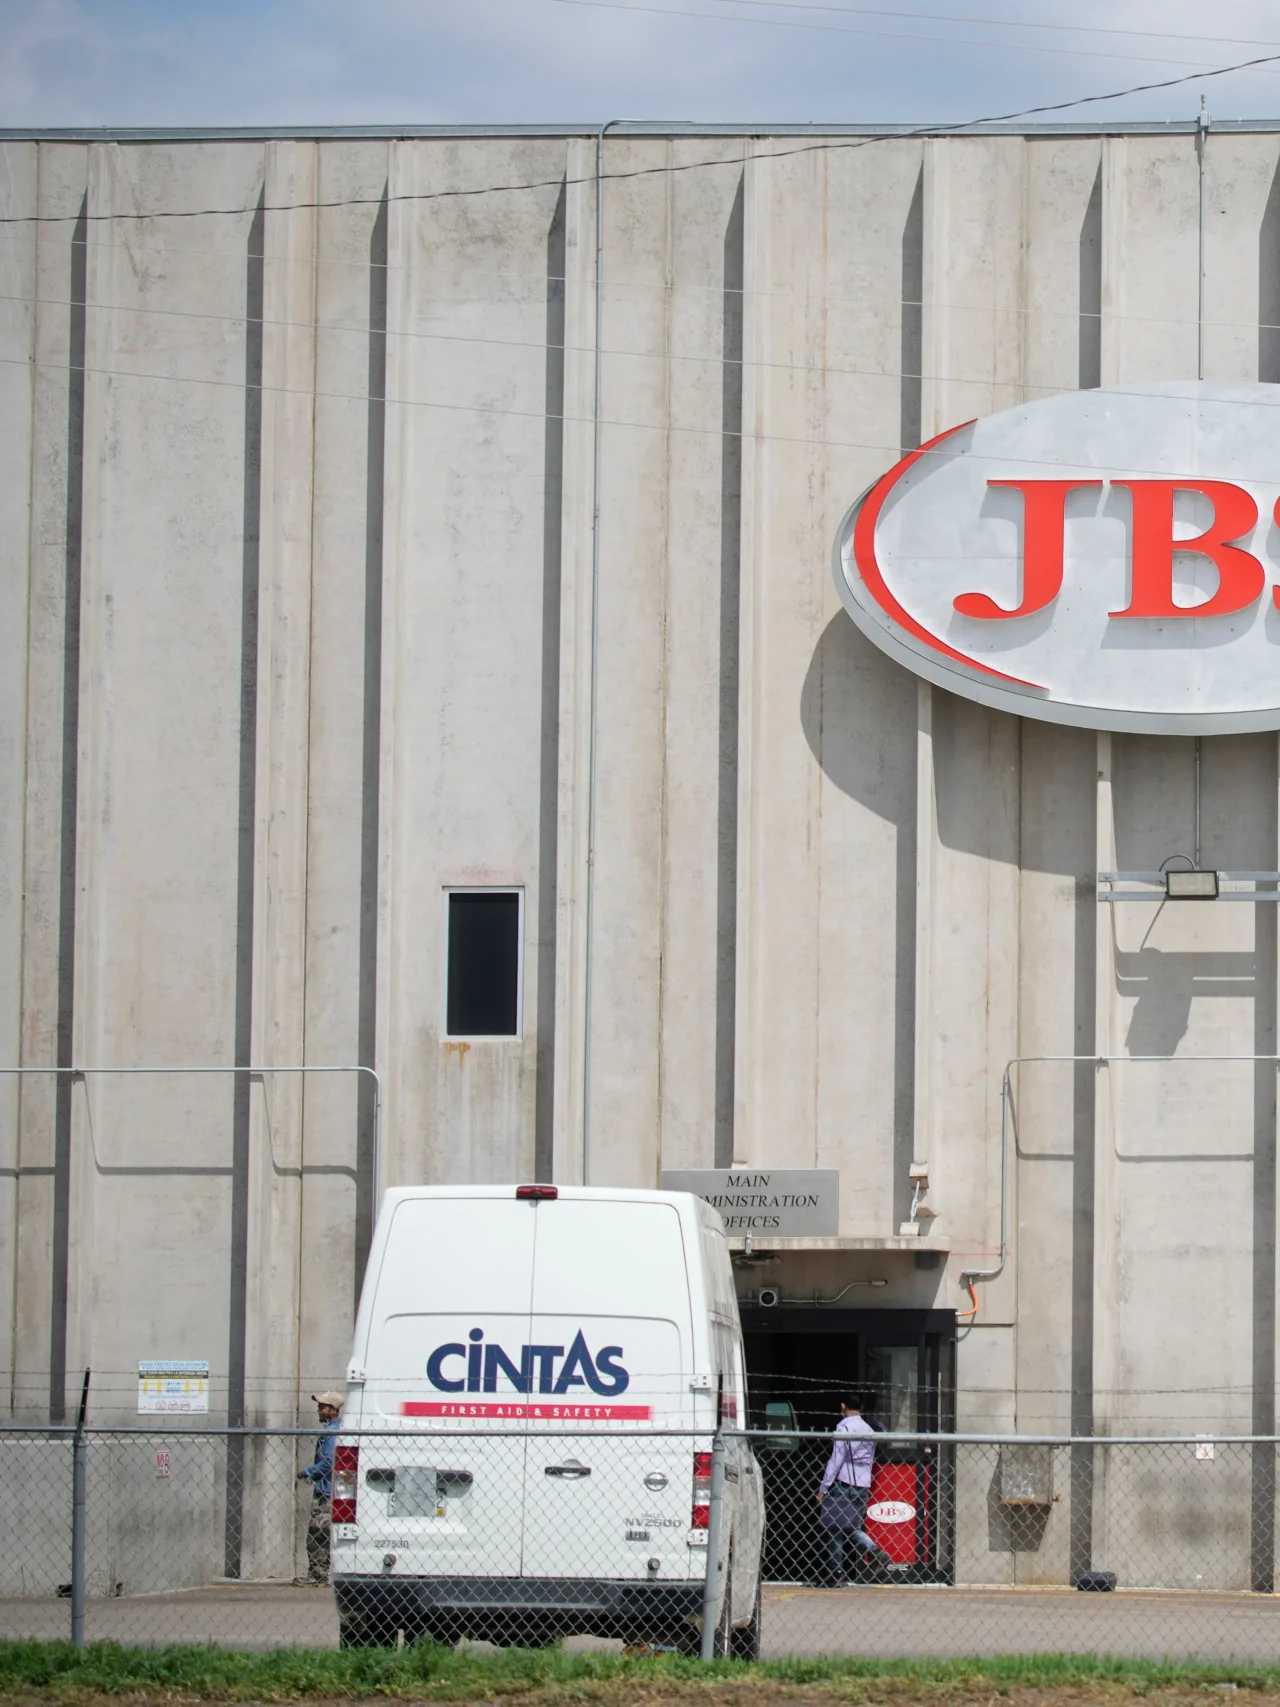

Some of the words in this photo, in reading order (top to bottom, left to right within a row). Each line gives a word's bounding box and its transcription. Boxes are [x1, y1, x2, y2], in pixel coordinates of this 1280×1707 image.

[726, 1175, 770, 1188] MAIN
[699, 1195, 819, 1208] MINISTRATION
[441, 1406, 487, 1414] FIRST
[497, 1407, 523, 1415] AID
[534, 1408, 542, 1416] &
[553, 1407, 612, 1417] SAFETY
[876, 1507, 906, 1517] JBS
[374, 1539, 409, 1549] 227530
